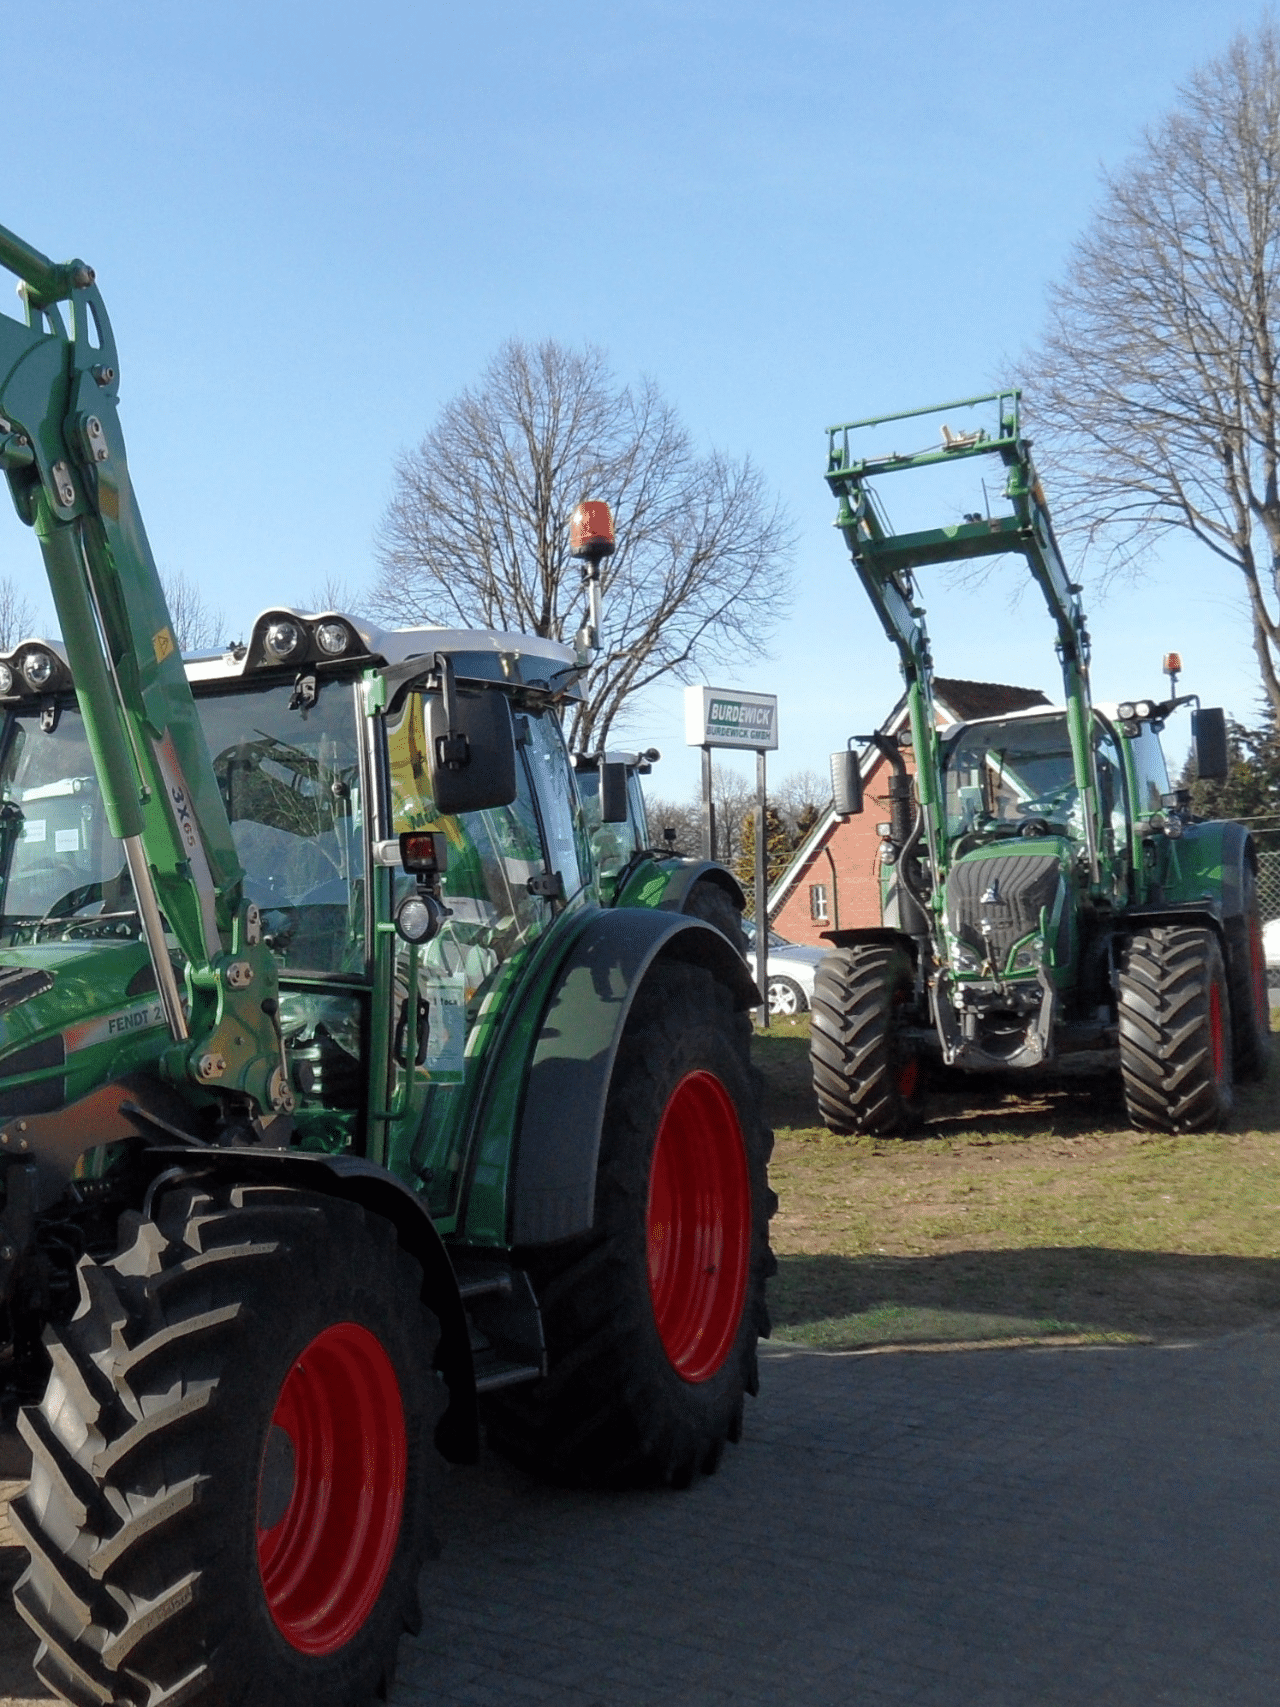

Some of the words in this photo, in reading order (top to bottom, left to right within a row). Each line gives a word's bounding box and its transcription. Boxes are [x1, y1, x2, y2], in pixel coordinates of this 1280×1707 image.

[711, 703, 771, 725] BURDEWICK
[706, 725, 749, 738] BURDEWICK
[171, 786, 196, 847] 3X65
[108, 1010, 149, 1034] FENDT
